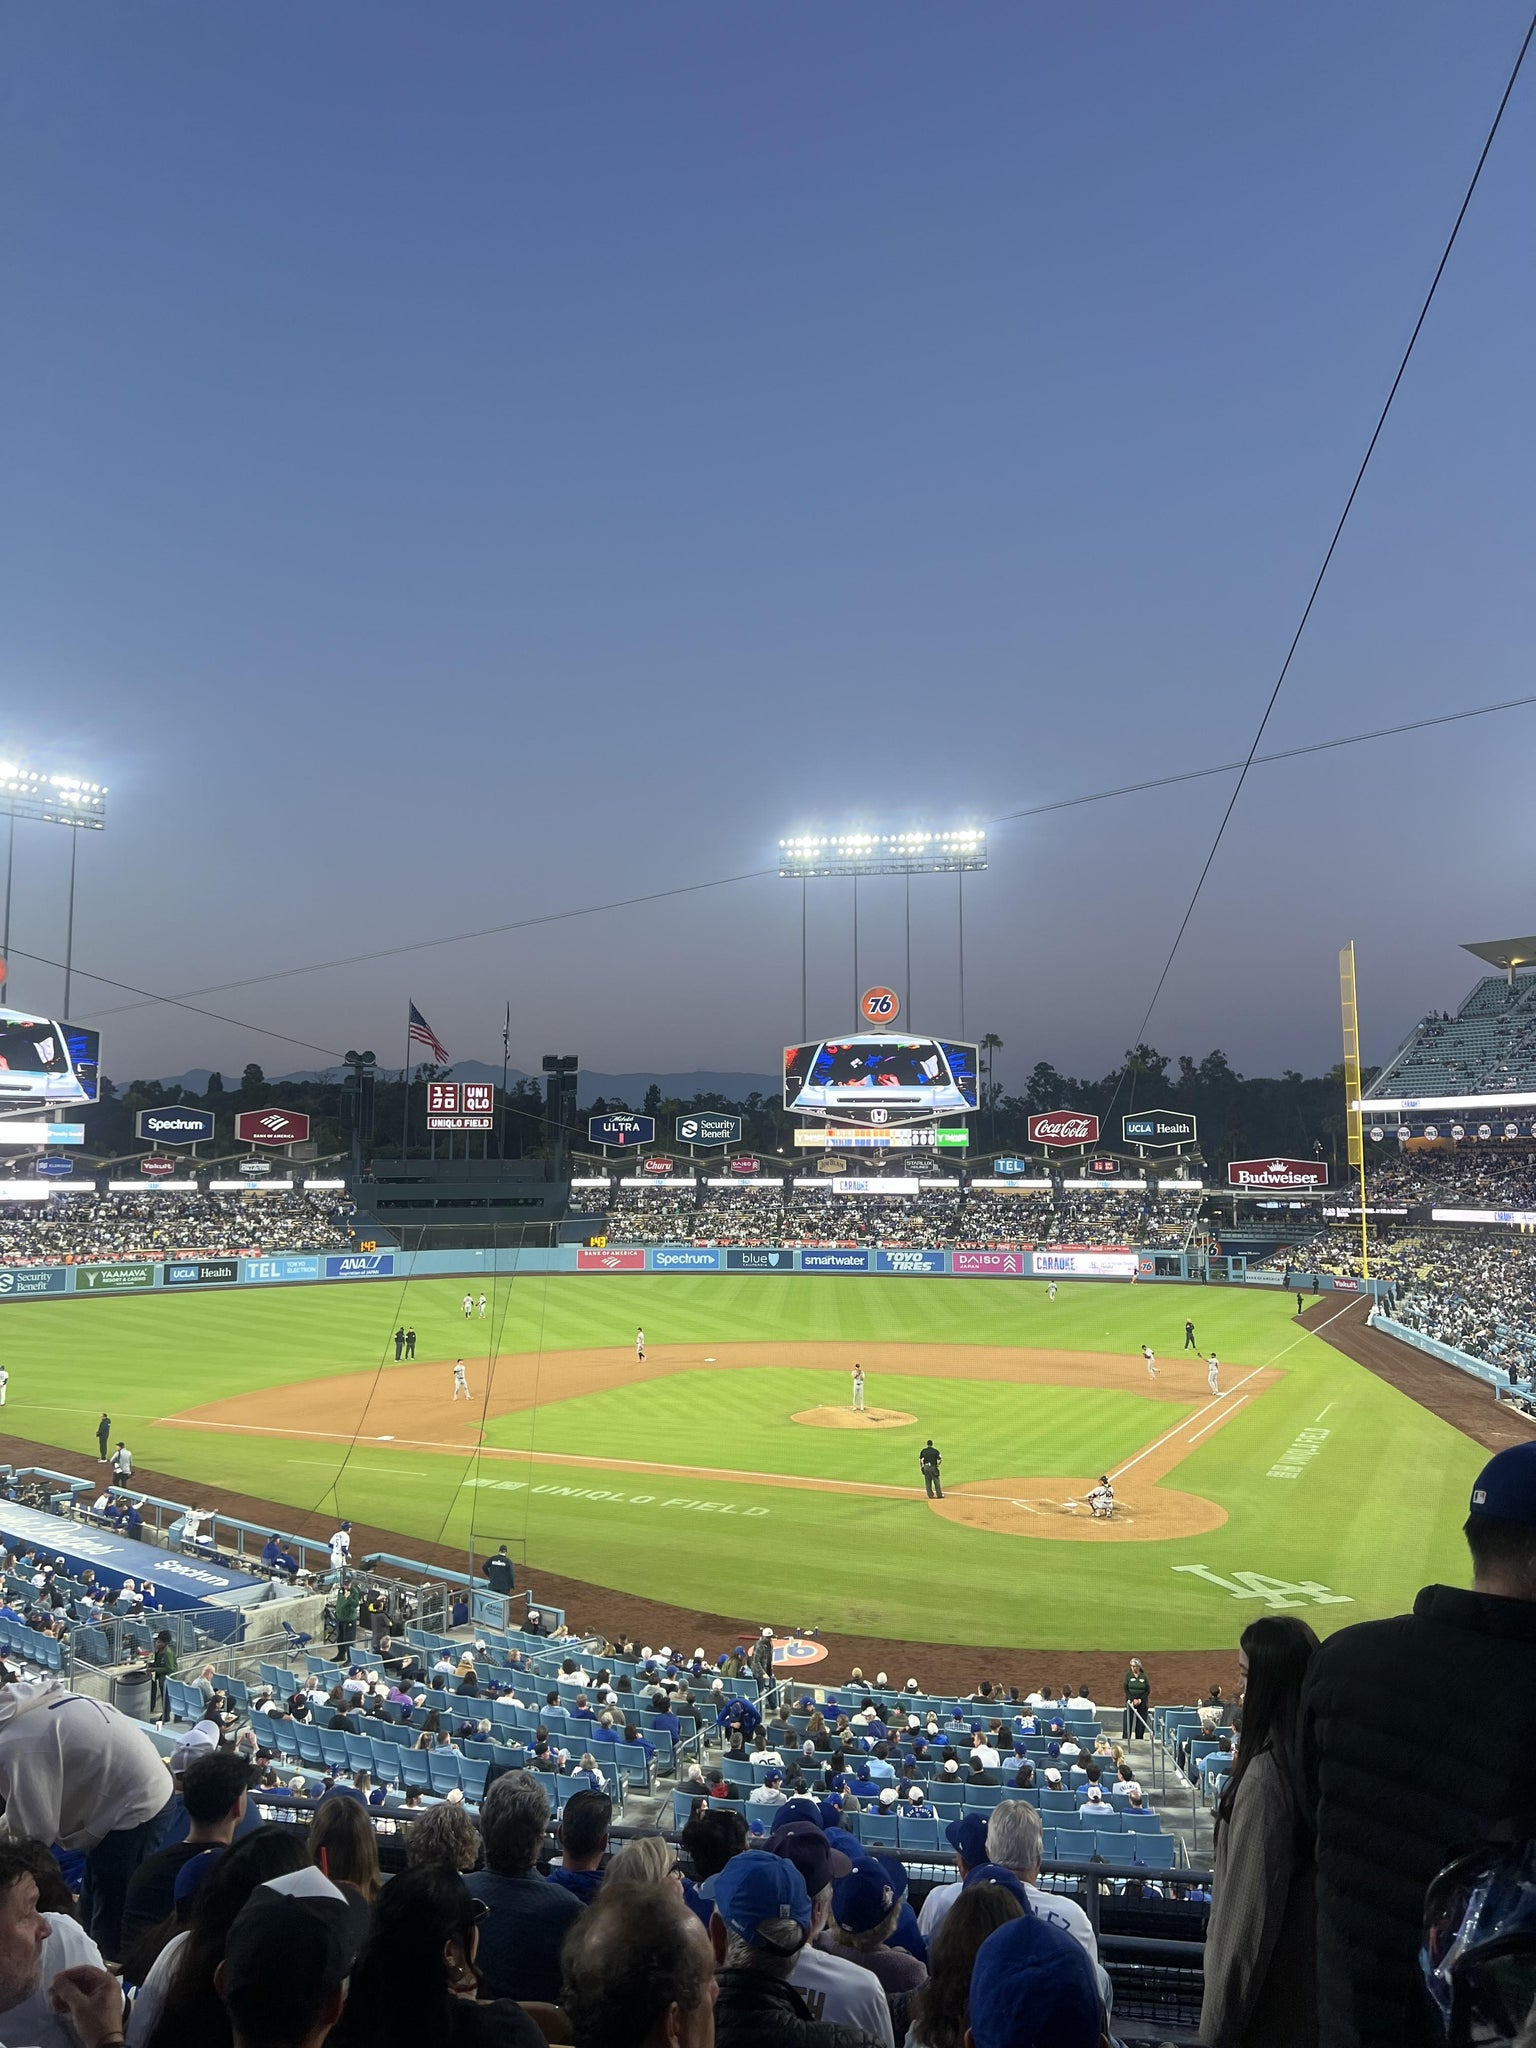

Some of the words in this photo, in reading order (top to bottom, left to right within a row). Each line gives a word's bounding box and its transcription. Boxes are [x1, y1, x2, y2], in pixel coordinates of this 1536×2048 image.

[867, 996, 893, 1014] 76
[467, 1087, 488, 1098] UNI
[467, 1098, 489, 1110] QLO
[148, 1118, 203, 1131] Spectrum
[431, 1119, 462, 1128] UNIQLO
[464, 1119, 489, 1127] FIELD
[603, 1123, 640, 1131] ULTRA
[701, 1120, 735, 1131] Security
[1035, 1119, 1091, 1138] Coca-Cola
[1128, 1125, 1151, 1133] UCLA
[1156, 1124, 1190, 1133] Health
[701, 1130, 731, 1138] Benefit
[645, 1160, 672, 1170] Churu
[998, 1161, 1021, 1171] TEL
[657, 1253, 711, 1267] Spectrum
[742, 1253, 767, 1263] blue
[805, 1255, 865, 1266] smartwater
[886, 1252, 923, 1262] TOYO
[959, 1256, 1000, 1264] DAISO
[340, 1258, 366, 1270] ANA
[892, 1261, 931, 1271] TIRES
[1140, 1262, 1152, 1271] 76
[173, 1269, 195, 1278] UCLA
[201, 1267, 232, 1278] Health
[248, 1262, 281, 1278] TEL
[16, 1272, 52, 1283] Security
[16, 1282, 47, 1291] Benefit
[1334, 1280, 1359, 1289] Yakult
[531, 1484, 656, 1504] UNIQLO
[660, 1498, 771, 1516] FIELD
[154, 1559, 227, 1587] Spectrum
[1170, 1564, 1356, 1609] LA
